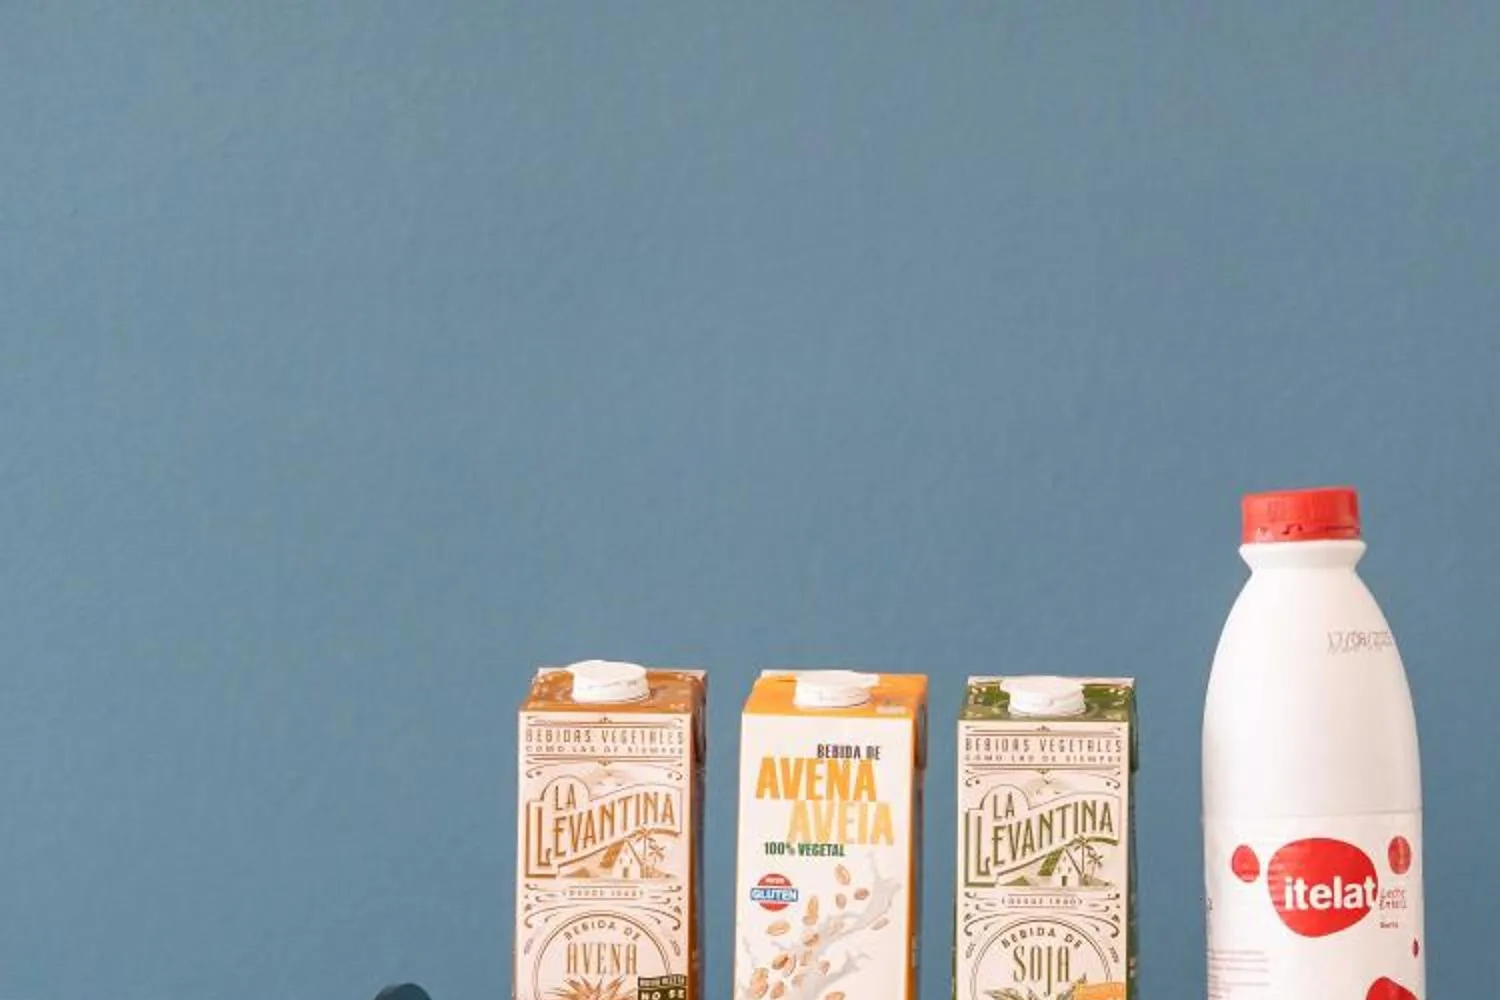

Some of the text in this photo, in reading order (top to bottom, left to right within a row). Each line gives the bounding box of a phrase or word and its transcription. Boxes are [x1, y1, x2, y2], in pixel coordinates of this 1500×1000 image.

[525, 729, 684, 745] BEBIDAS VEGETALES
[965, 737, 1122, 753] BEBIDAS VEGETALES
[816, 744, 881, 761] BEBIDA DE
[755, 757, 877, 801] AVENA
[554, 782, 577, 812] LA
[992, 791, 1015, 820] LA
[536, 791, 676, 868] LEVANTINA
[787, 801, 895, 847] AVEIA
[976, 799, 1114, 877] LEVANTINA
[763, 841, 846, 857] 100% VEGETAL
[752, 888, 798, 901] GLUTEN
[1283, 875, 1376, 911] itelat
[563, 919, 642, 941] BEBIDA DE
[1001, 927, 1056, 949] BEBIDA
[566, 942, 638, 975] AVENA
[1012, 945, 1070, 997] SOJA
[641, 989, 684, 1000] NO SE
